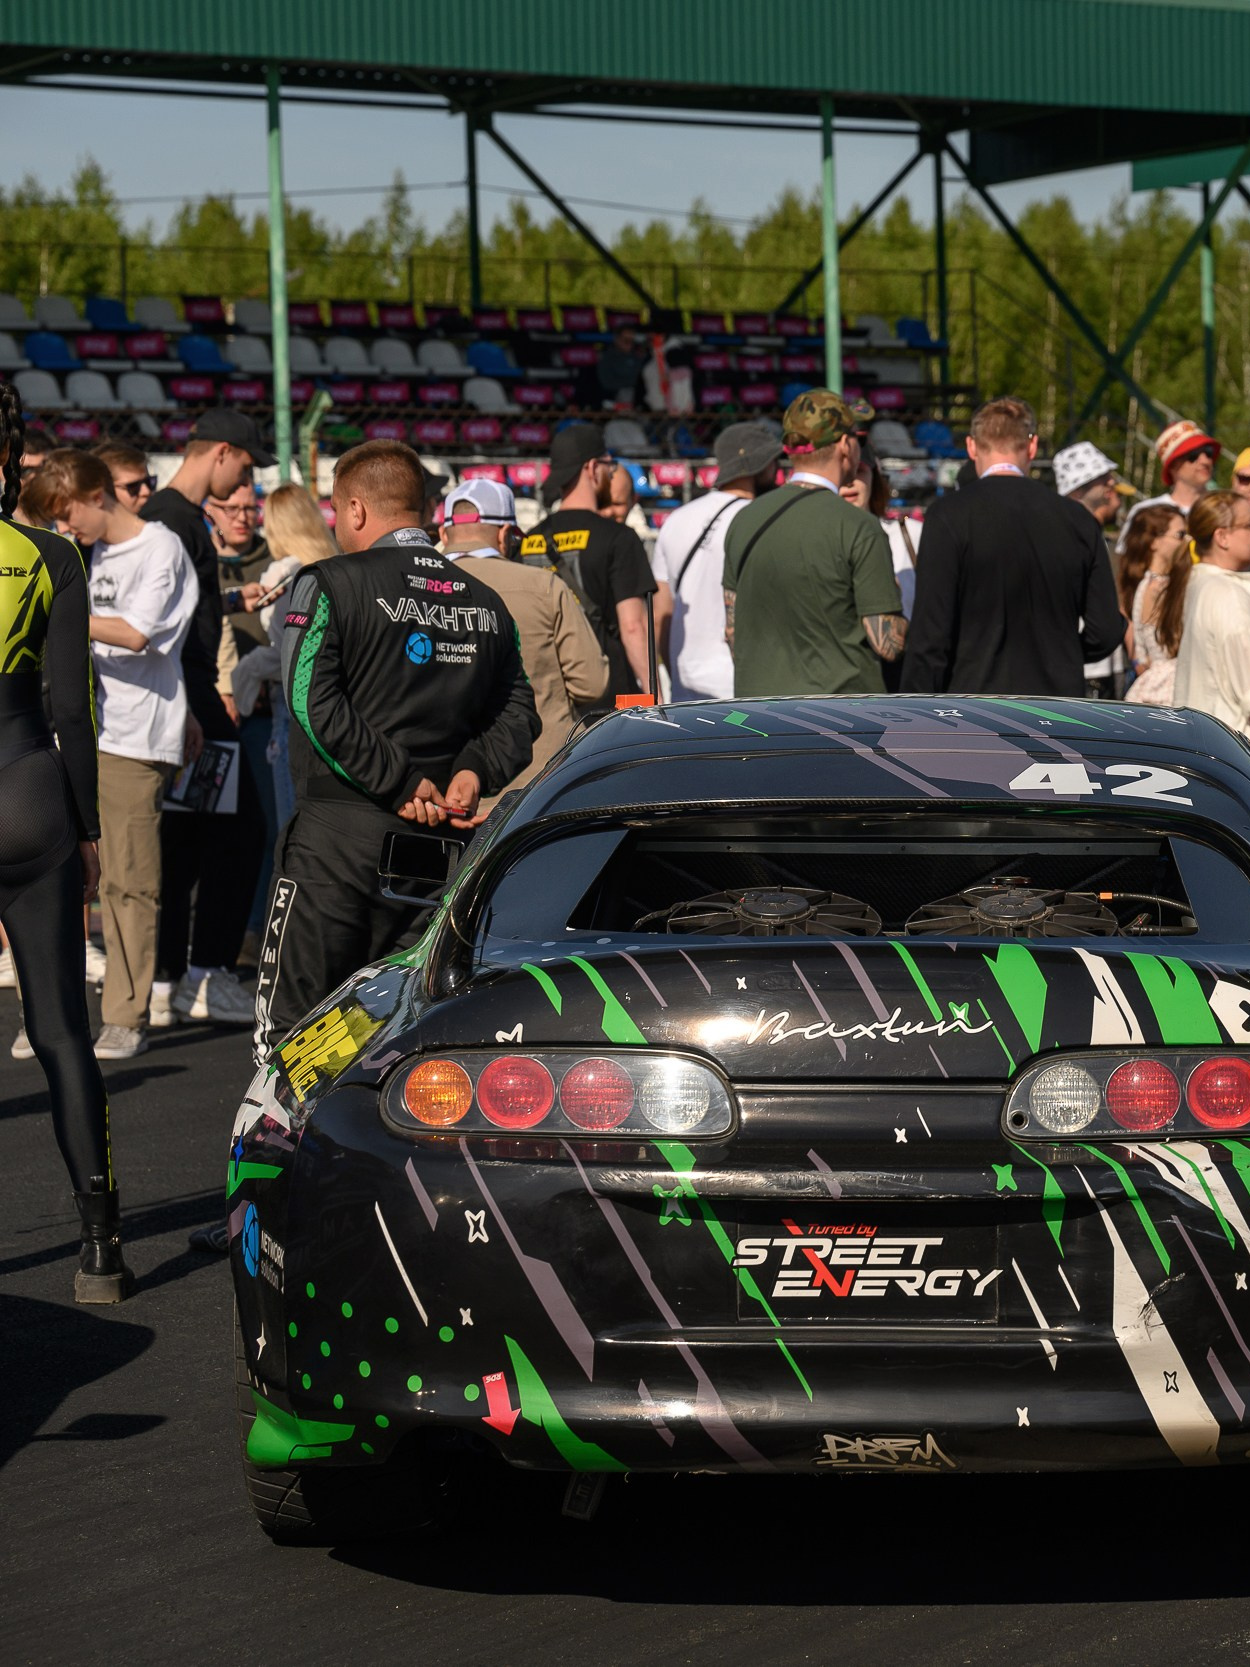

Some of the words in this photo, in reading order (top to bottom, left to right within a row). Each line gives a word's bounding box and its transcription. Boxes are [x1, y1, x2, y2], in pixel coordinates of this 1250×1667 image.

[413, 556, 444, 569] HRX
[426, 578, 453, 594] RDS
[452, 581, 466, 591] GP
[376, 597, 499, 634] VAKHTIN
[435, 642, 478, 653] NETWORK
[435, 652, 472, 664] solutions
[1008, 762, 1194, 807] 42
[258, 886, 291, 991] TEAM
[807, 1223, 854, 1235] Tuned
[856, 1223, 878, 1237] by
[733, 1237, 944, 1267] STREET
[771, 1268, 1004, 1297] ENERGY
